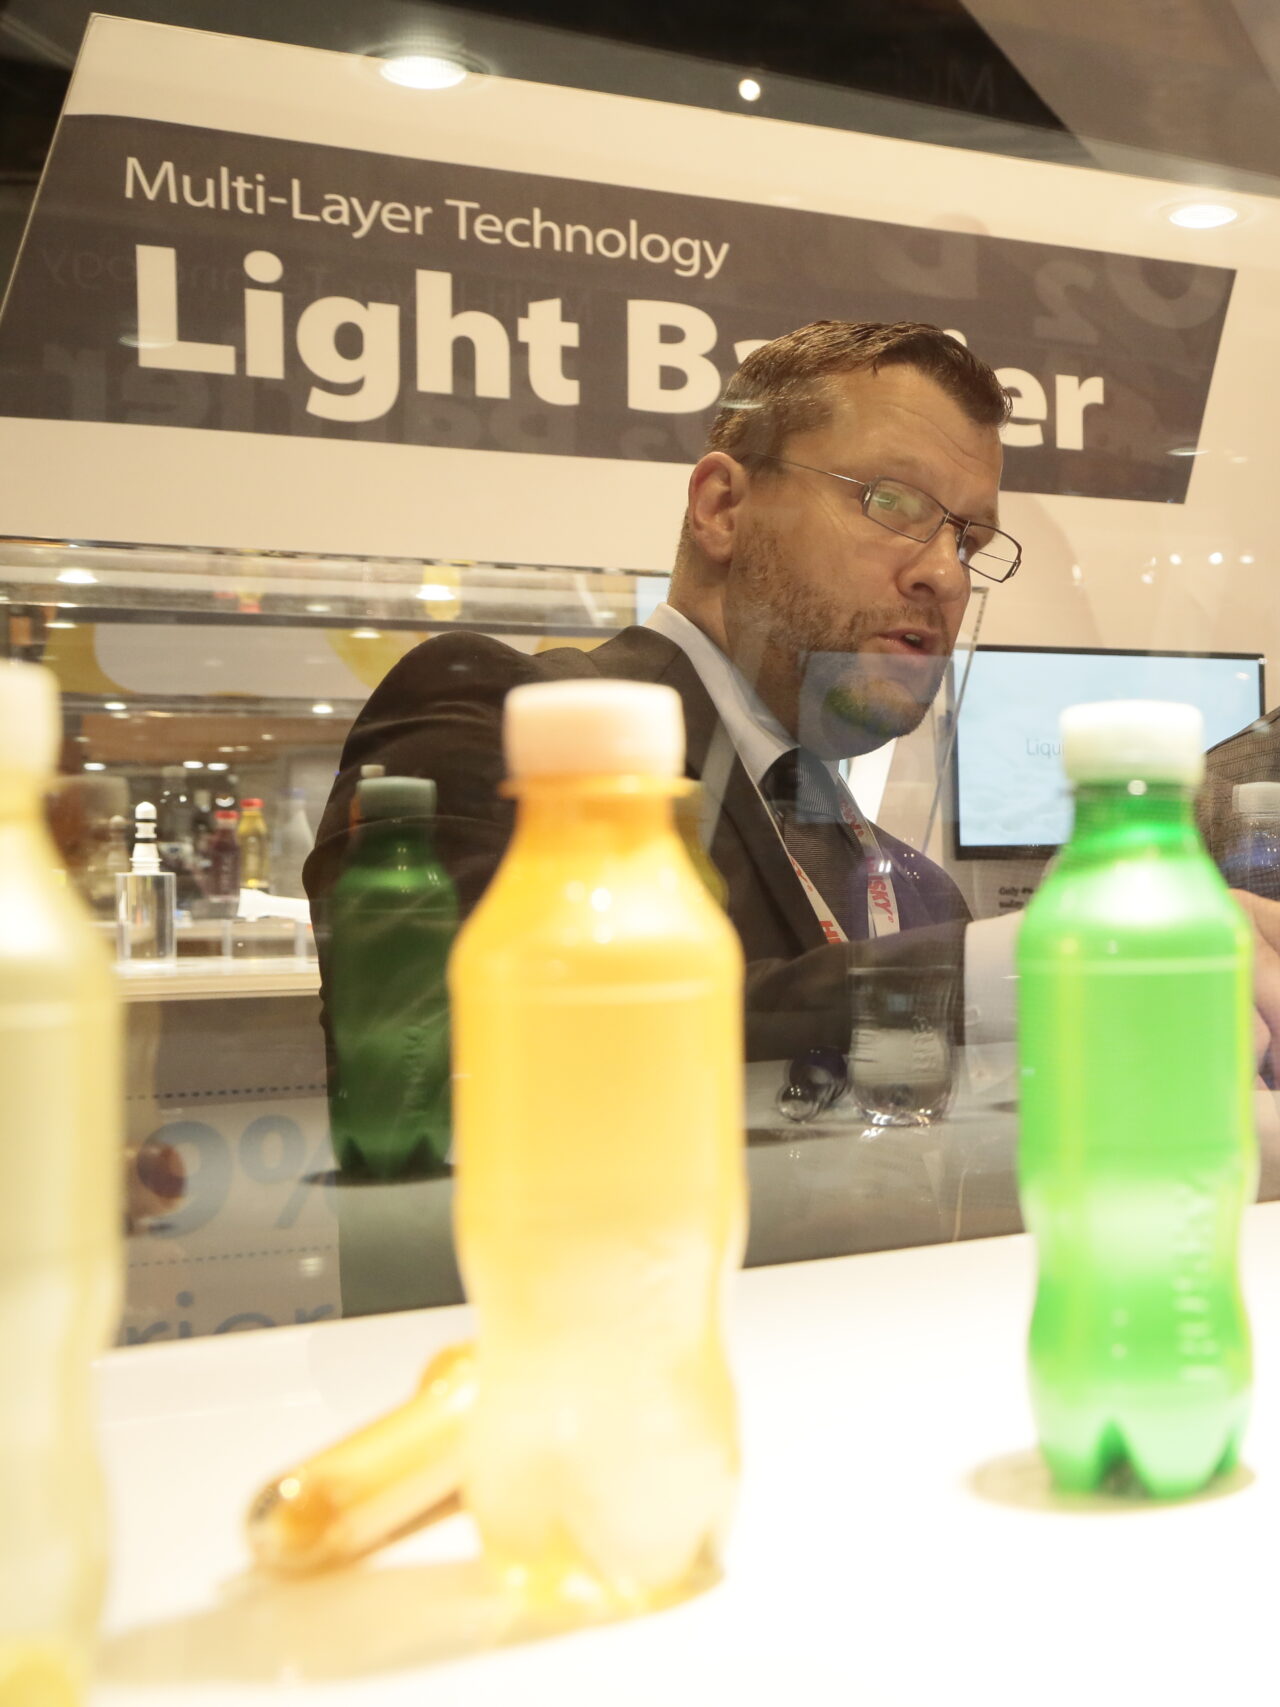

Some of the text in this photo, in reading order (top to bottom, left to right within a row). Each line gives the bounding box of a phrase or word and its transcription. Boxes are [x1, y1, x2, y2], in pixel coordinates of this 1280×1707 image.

[124, 156, 730, 280] Multi-Layer Technology
[135, 243, 580, 423] Light
